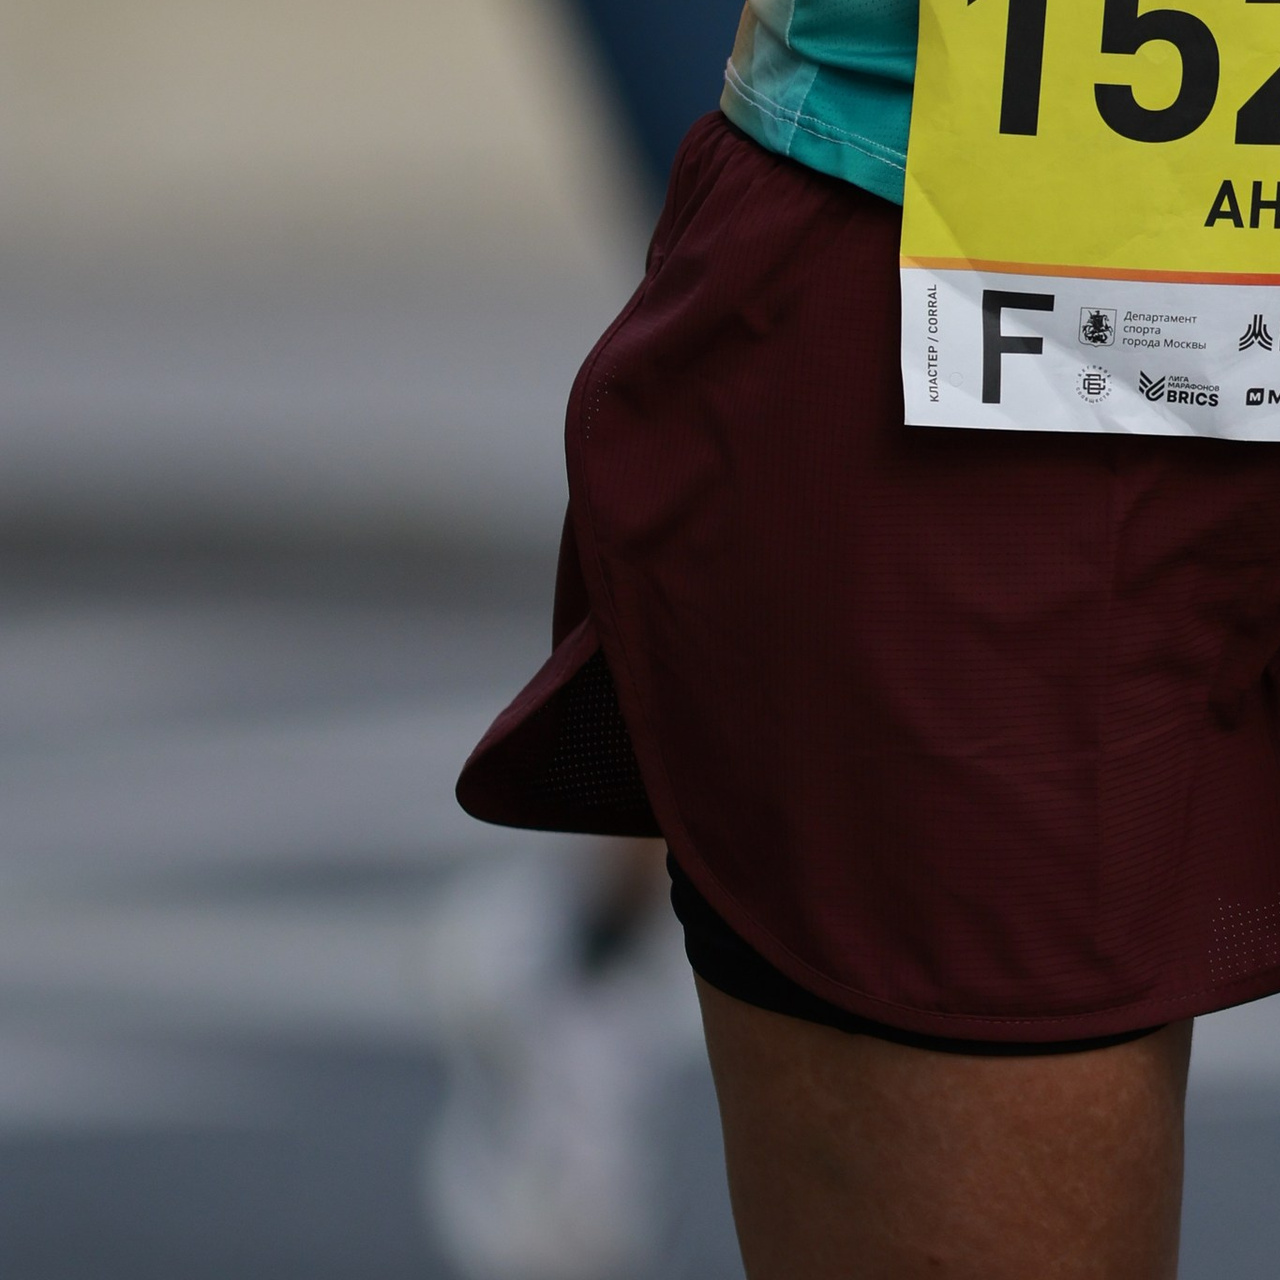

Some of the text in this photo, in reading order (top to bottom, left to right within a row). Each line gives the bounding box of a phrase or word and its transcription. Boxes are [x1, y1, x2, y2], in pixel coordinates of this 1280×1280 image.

[927, 284, 939, 334] CORRAL
[1123, 311, 1198, 324] Департамент
[1123, 325, 1162, 336] спорта
[982, 289, 1055, 404] F
[1122, 337, 1207, 350] города Москвы
[927, 345, 940, 403] КЛАСТЕР
[1168, 375, 1189, 383] ЛИГА
[1167, 382, 1220, 393] МАРАФОНОВ
[1166, 390, 1220, 407] BRICS
